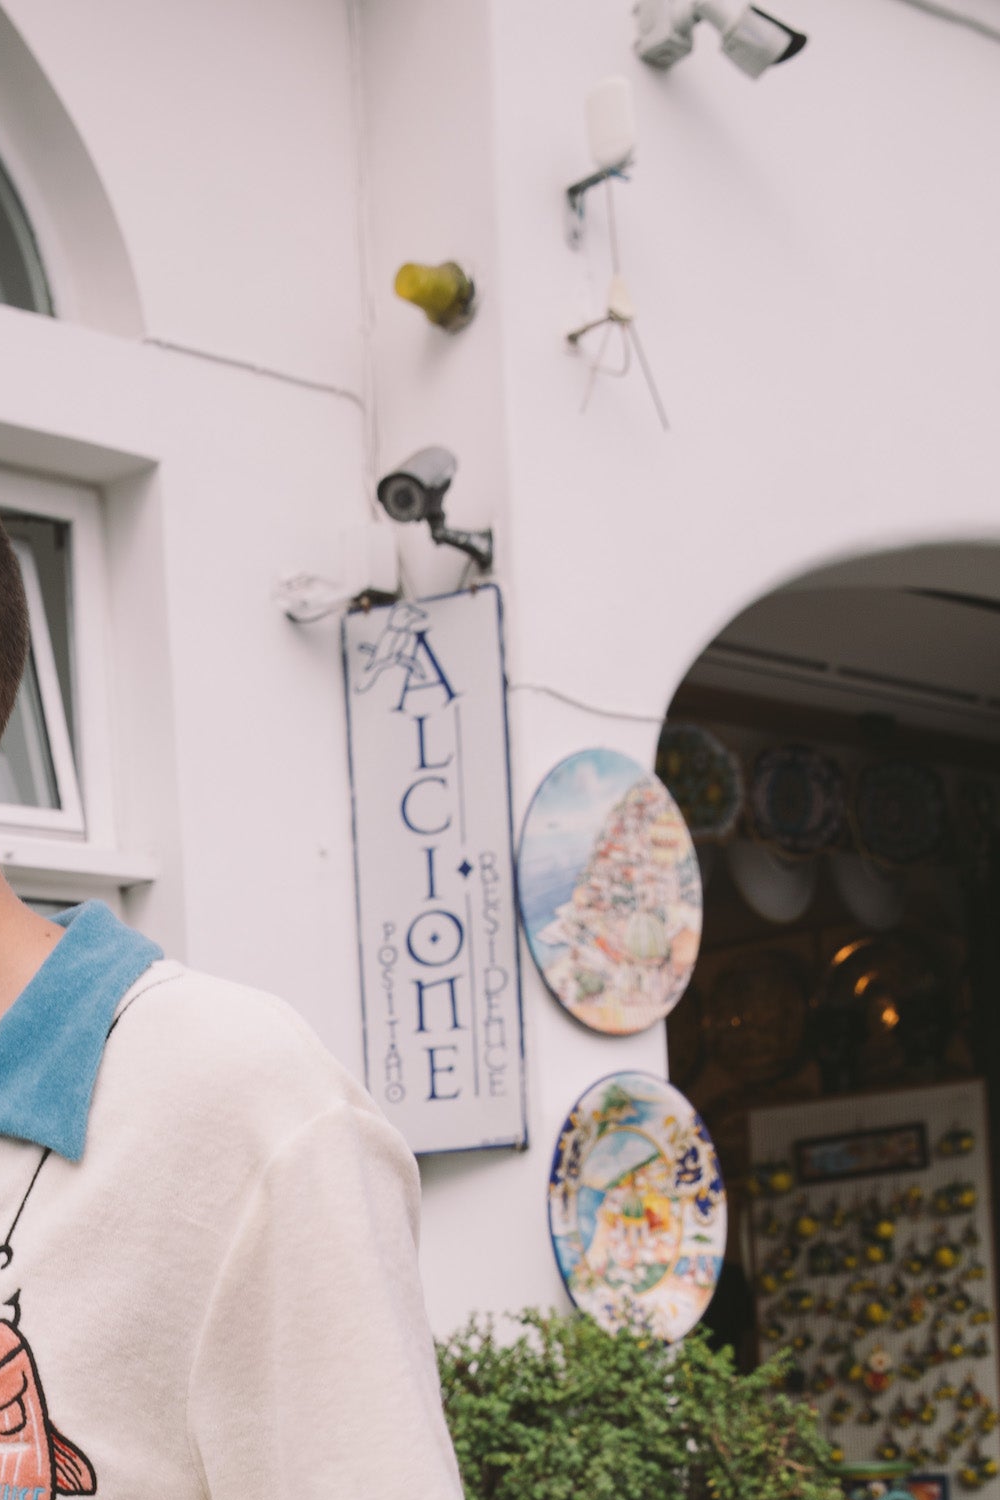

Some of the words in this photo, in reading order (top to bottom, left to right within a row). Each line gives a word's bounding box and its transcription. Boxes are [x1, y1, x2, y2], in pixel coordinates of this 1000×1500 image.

[390, 627, 466, 1101] ALCIONE
[478, 851, 508, 1098] RESIDENCE
[378, 921, 406, 1103] POSITANO
